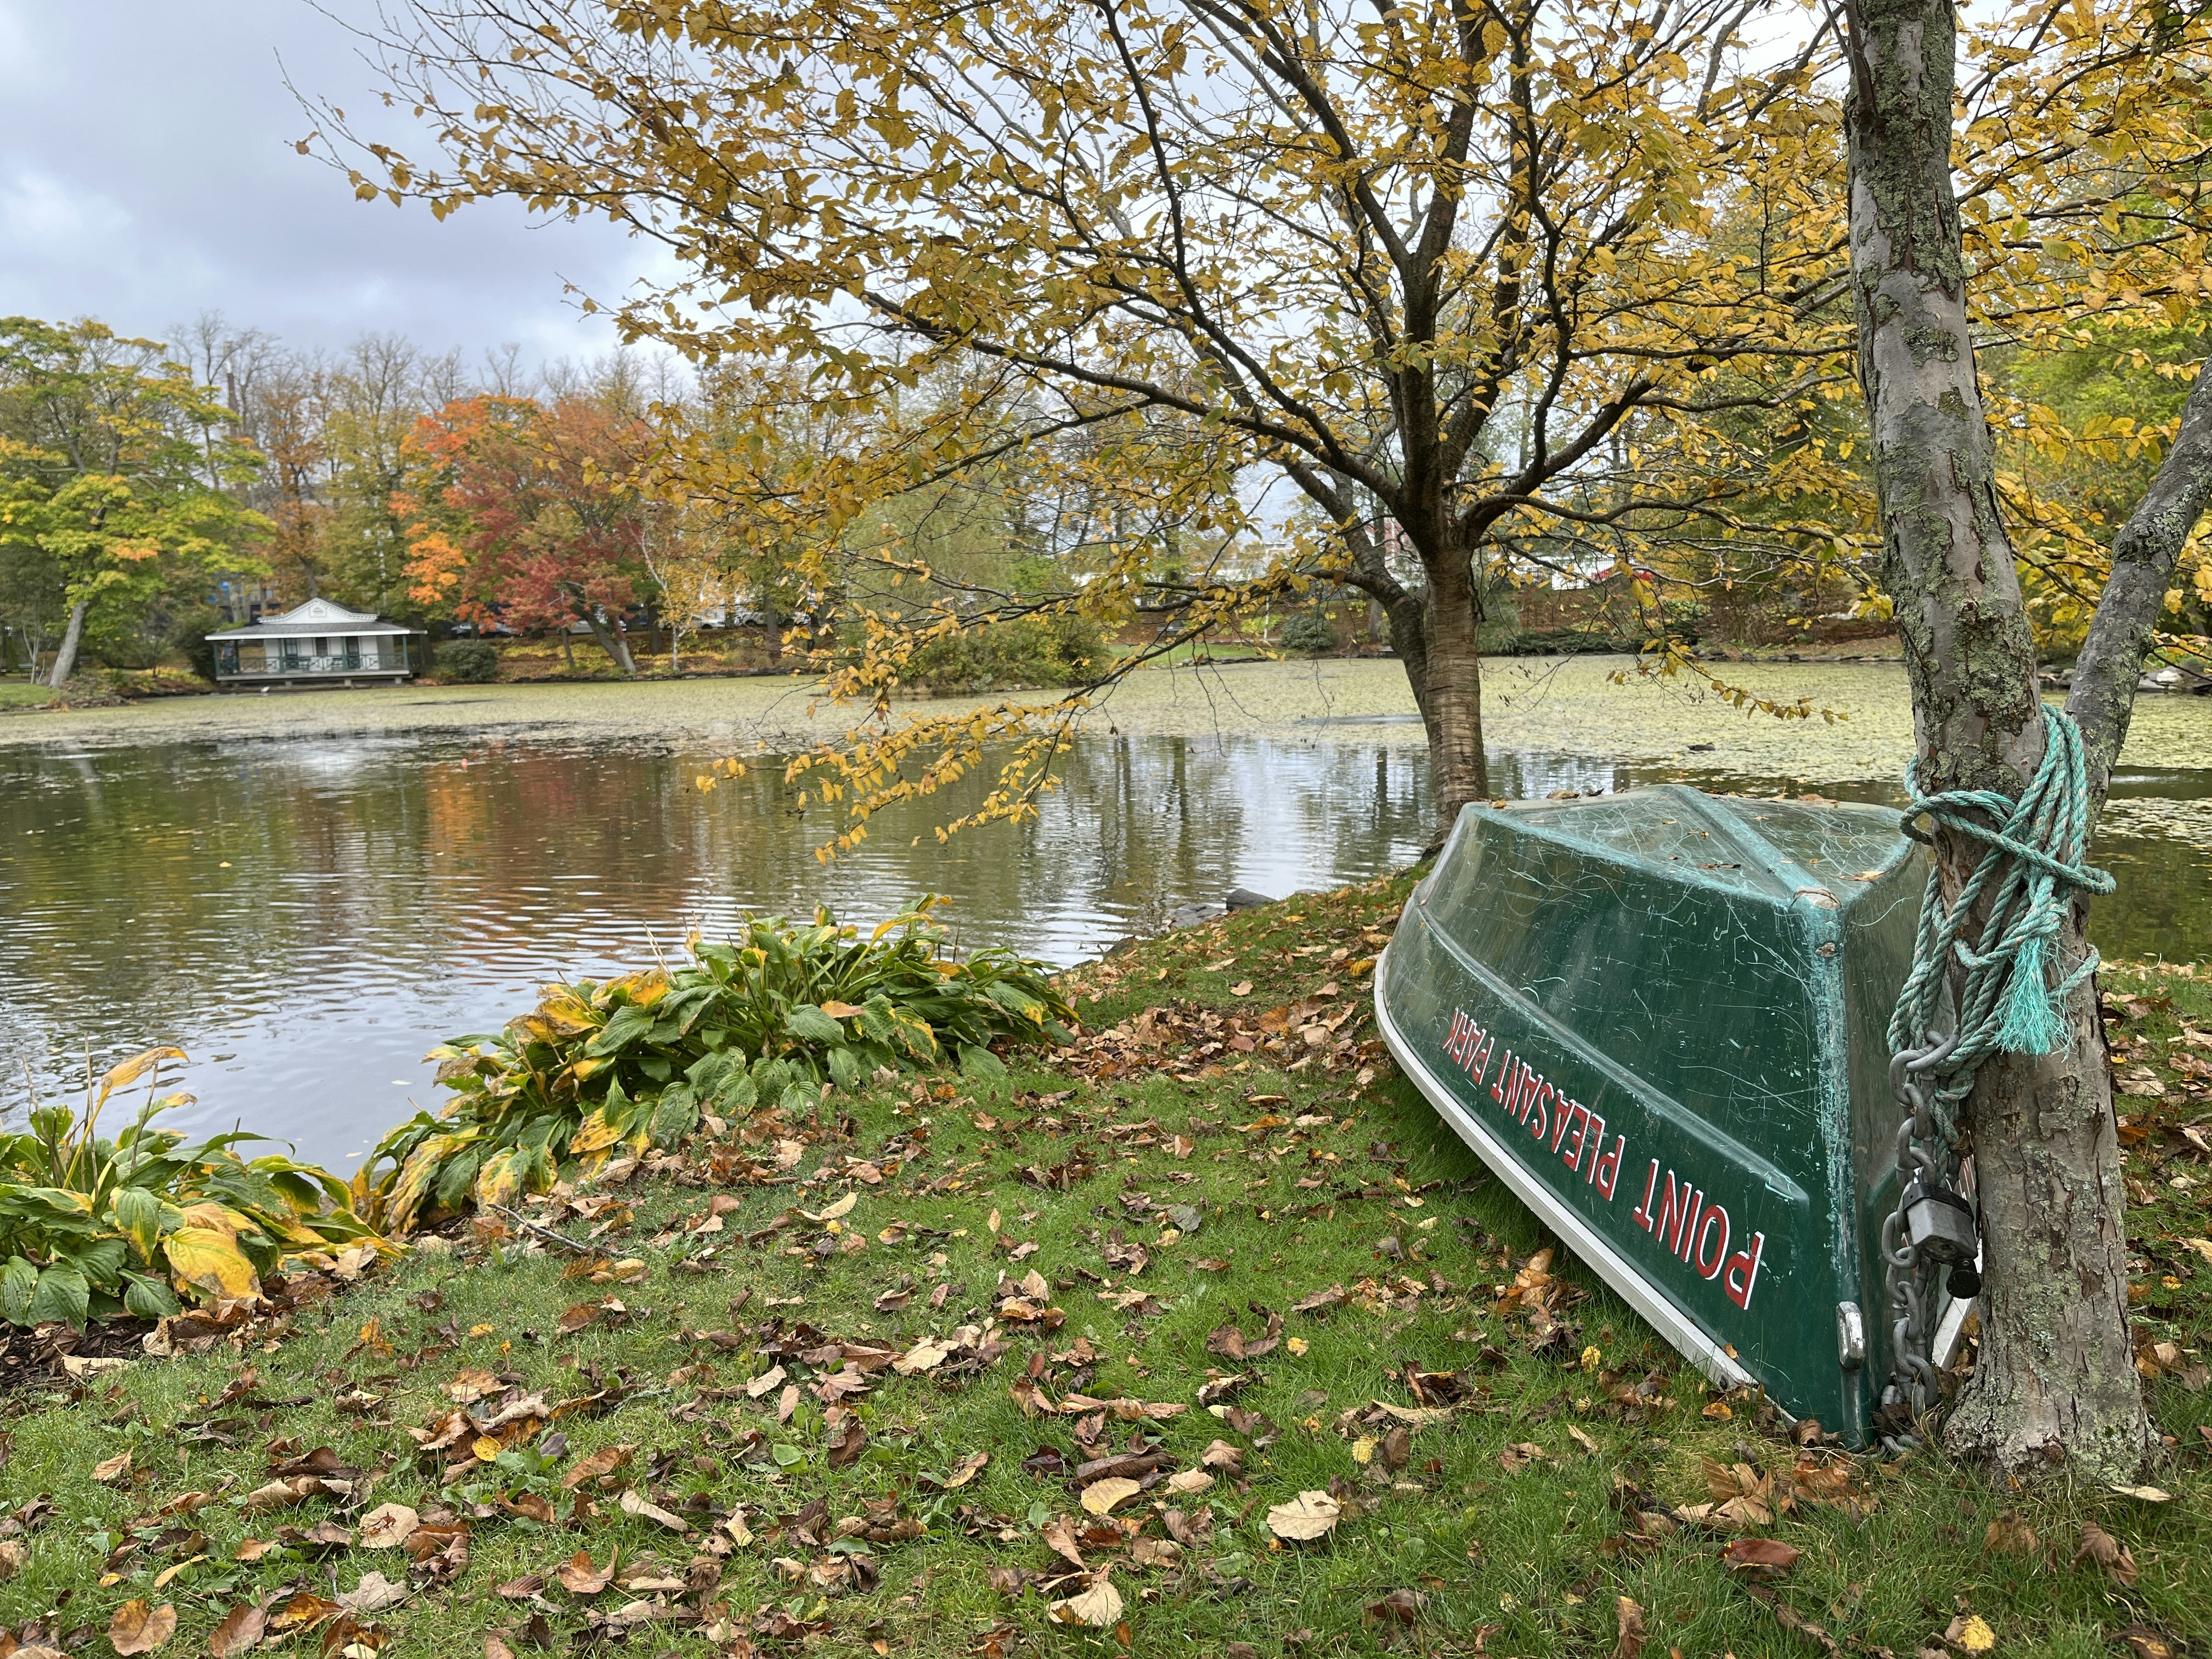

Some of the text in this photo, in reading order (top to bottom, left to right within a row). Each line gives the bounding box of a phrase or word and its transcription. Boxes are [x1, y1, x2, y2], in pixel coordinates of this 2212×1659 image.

[1442, 1007, 1765, 1310] POINT PLEASANT PARK
